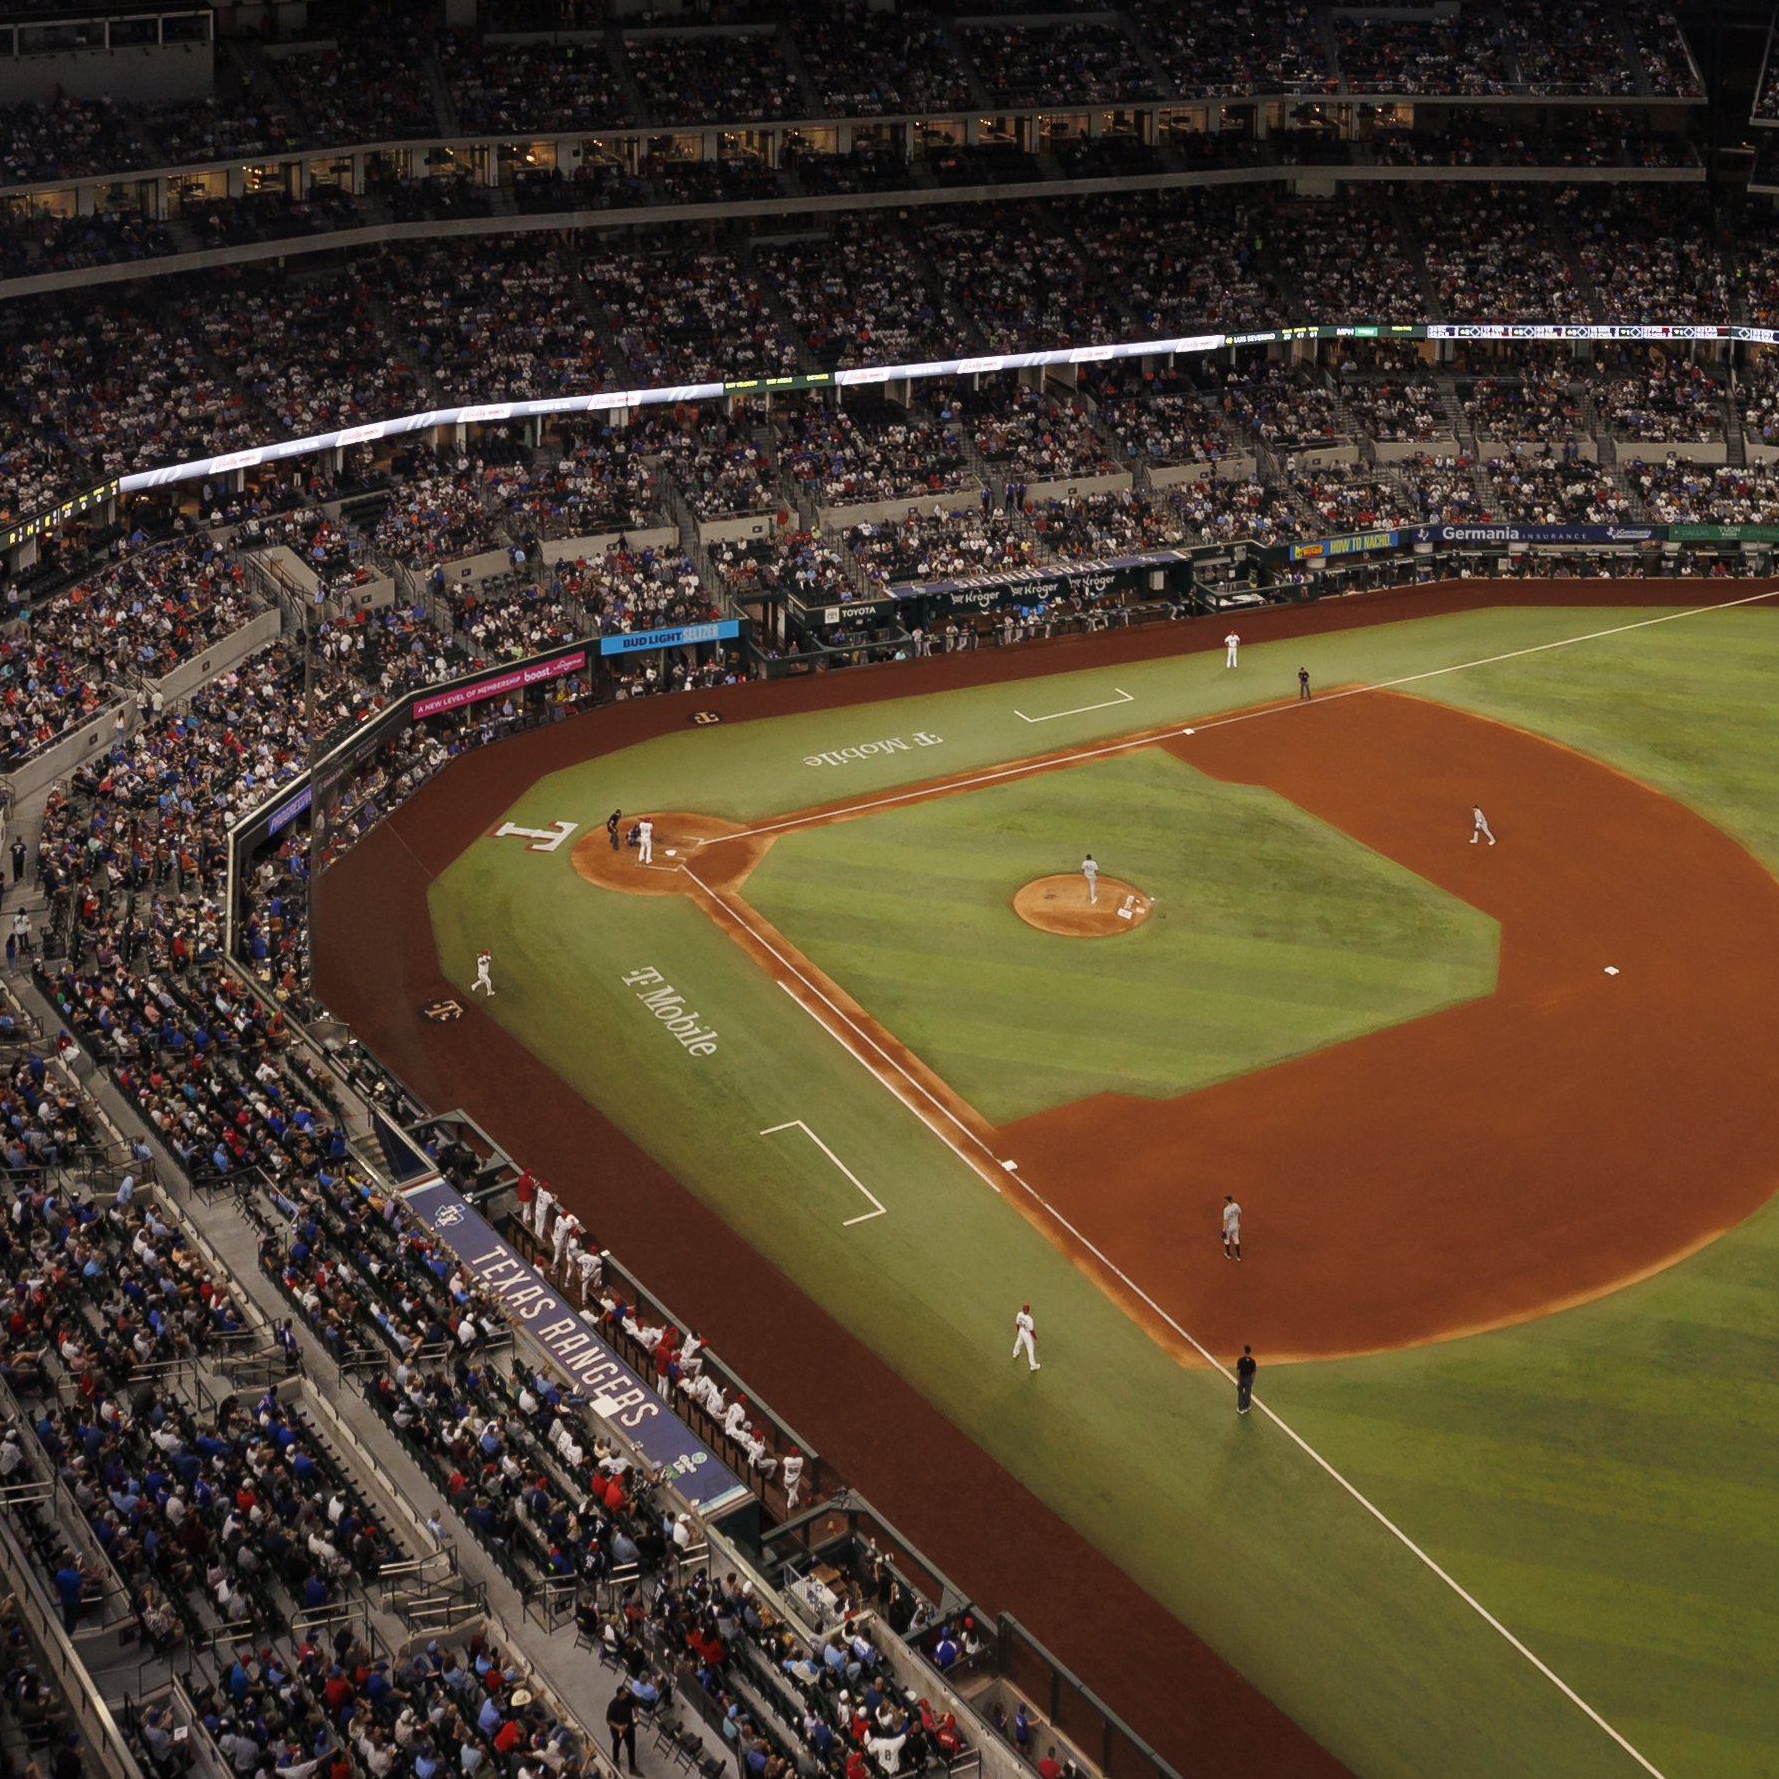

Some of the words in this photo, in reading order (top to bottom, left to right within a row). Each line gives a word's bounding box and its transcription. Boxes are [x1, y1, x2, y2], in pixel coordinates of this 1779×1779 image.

[1442, 526, 1519, 541] Germania
[1522, 532, 1588, 540] INSURANCE
[1329, 538, 1349, 554] HOW
[1352, 536, 1361, 550] TO
[1049, 560, 1115, 576] TEXAS
[953, 568, 1047, 589] RANGERS
[1081, 573, 1116, 590] Kroger
[965, 589, 1001, 605] Kroger
[1024, 581, 1058, 599] Kroger
[841, 605, 877, 618] TOYOTA
[622, 636, 648, 648] BUD
[648, 632, 682, 645] LIGHT
[682, 624, 719, 642] SELTZER
[425, 702, 441, 712] NEW
[443, 695, 466, 709] LEVEL
[466, 691, 477, 700] OF
[477, 676, 521, 697] MEMBERSHIP
[524, 666, 551, 683] boost
[802, 736, 910, 767] Mobile
[487, 820, 579, 853] T
[642, 981, 719, 1058] Mobile
[471, 1244, 557, 1321] TEXAS
[537, 1316, 659, 1428] RANGERS
